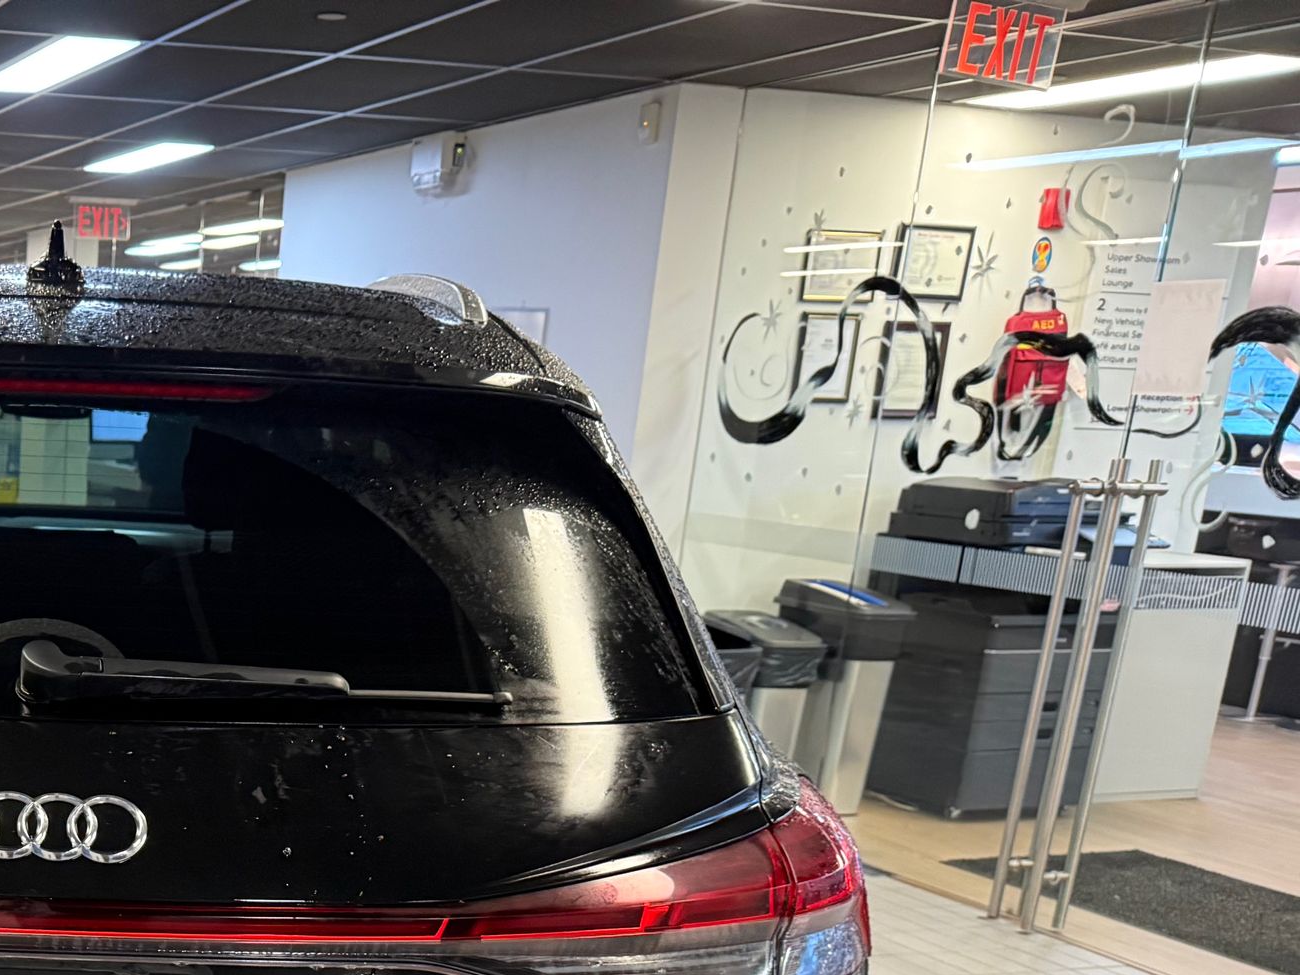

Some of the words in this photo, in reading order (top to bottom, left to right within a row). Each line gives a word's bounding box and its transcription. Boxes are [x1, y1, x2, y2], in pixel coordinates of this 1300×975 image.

[957, 1, 1055, 85] EXIT
[78, 206, 122, 240] EXIT
[1107, 252, 1133, 263] Upper
[1134, 253, 1181, 265] Showom
[1104, 264, 1127, 275] Sales
[1102, 278, 1134, 289] Lounge
[1097, 297, 1106, 311] 2
[1032, 319, 1055, 330] AED
[1092, 328, 1130, 338] Financial
[1110, 342, 1126, 351] and
[1140, 393, 1183, 402] Reception
[1106, 404, 1132, 412] Lowe
